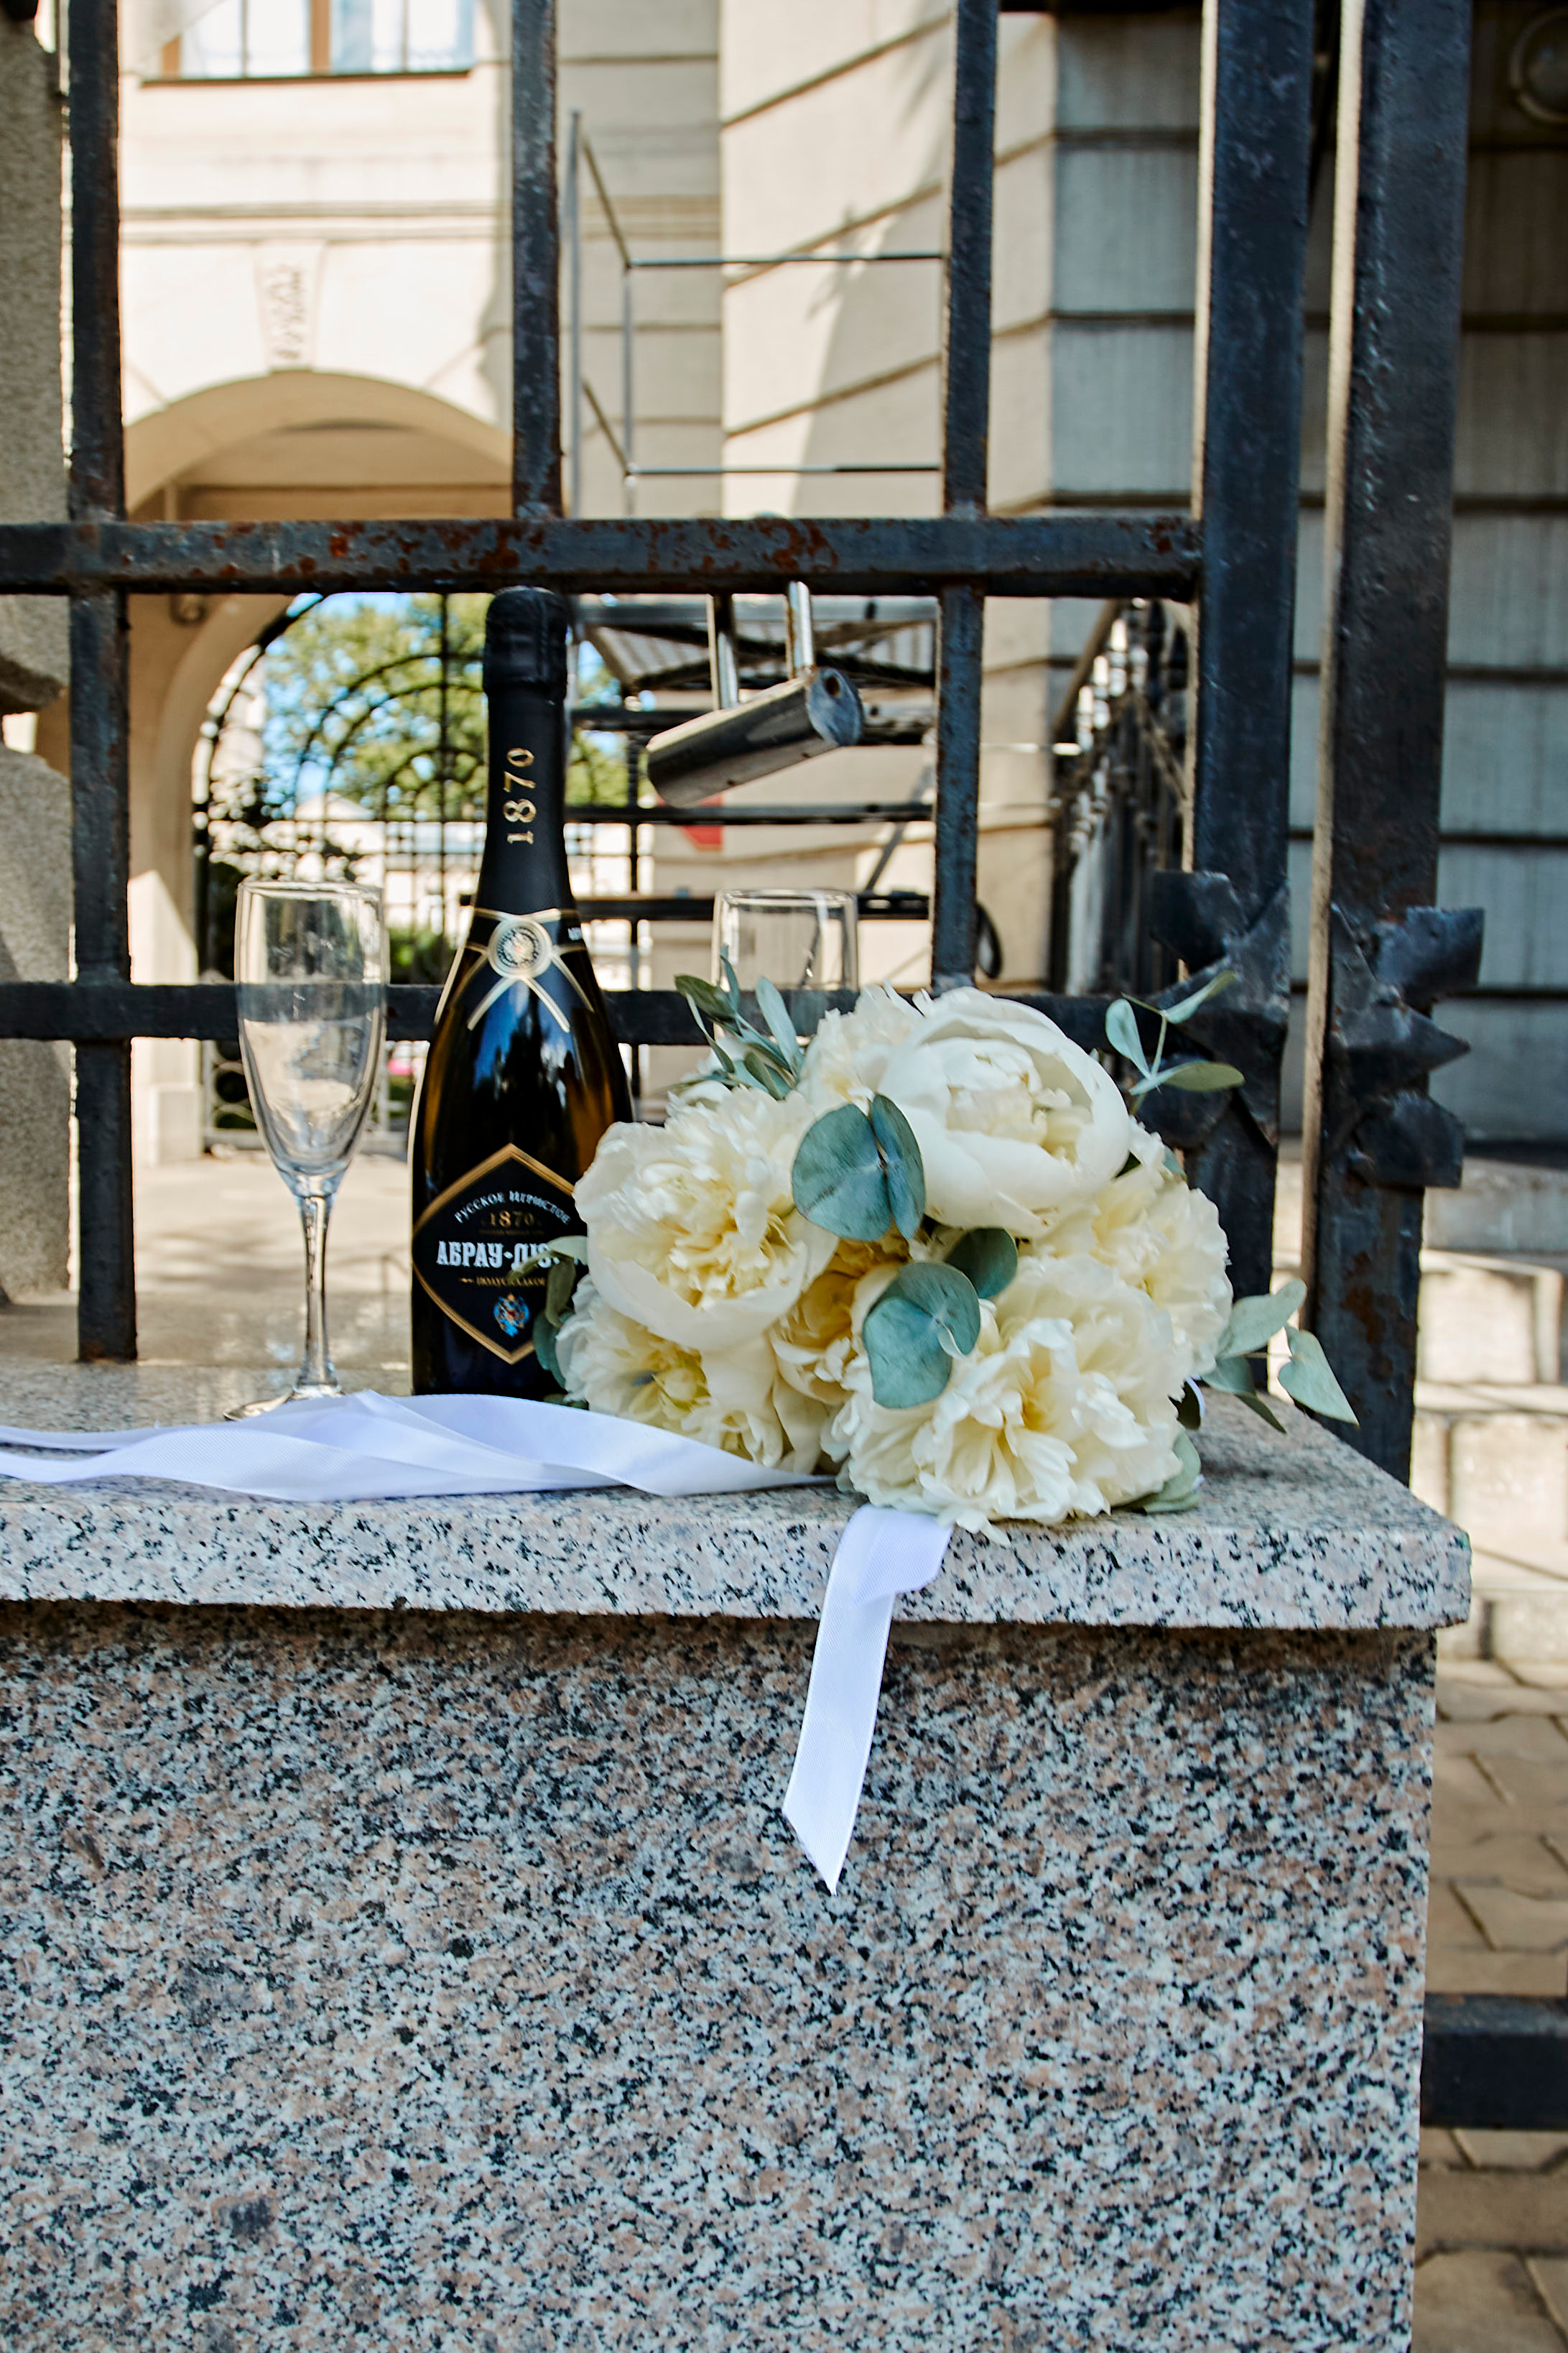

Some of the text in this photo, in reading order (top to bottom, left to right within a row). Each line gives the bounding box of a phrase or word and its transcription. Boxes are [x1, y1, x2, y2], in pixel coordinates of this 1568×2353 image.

[504, 747, 537, 844] 1870
[454, 1192, 506, 1224] РУССКОЕ
[489, 1210, 535, 1227] 1870
